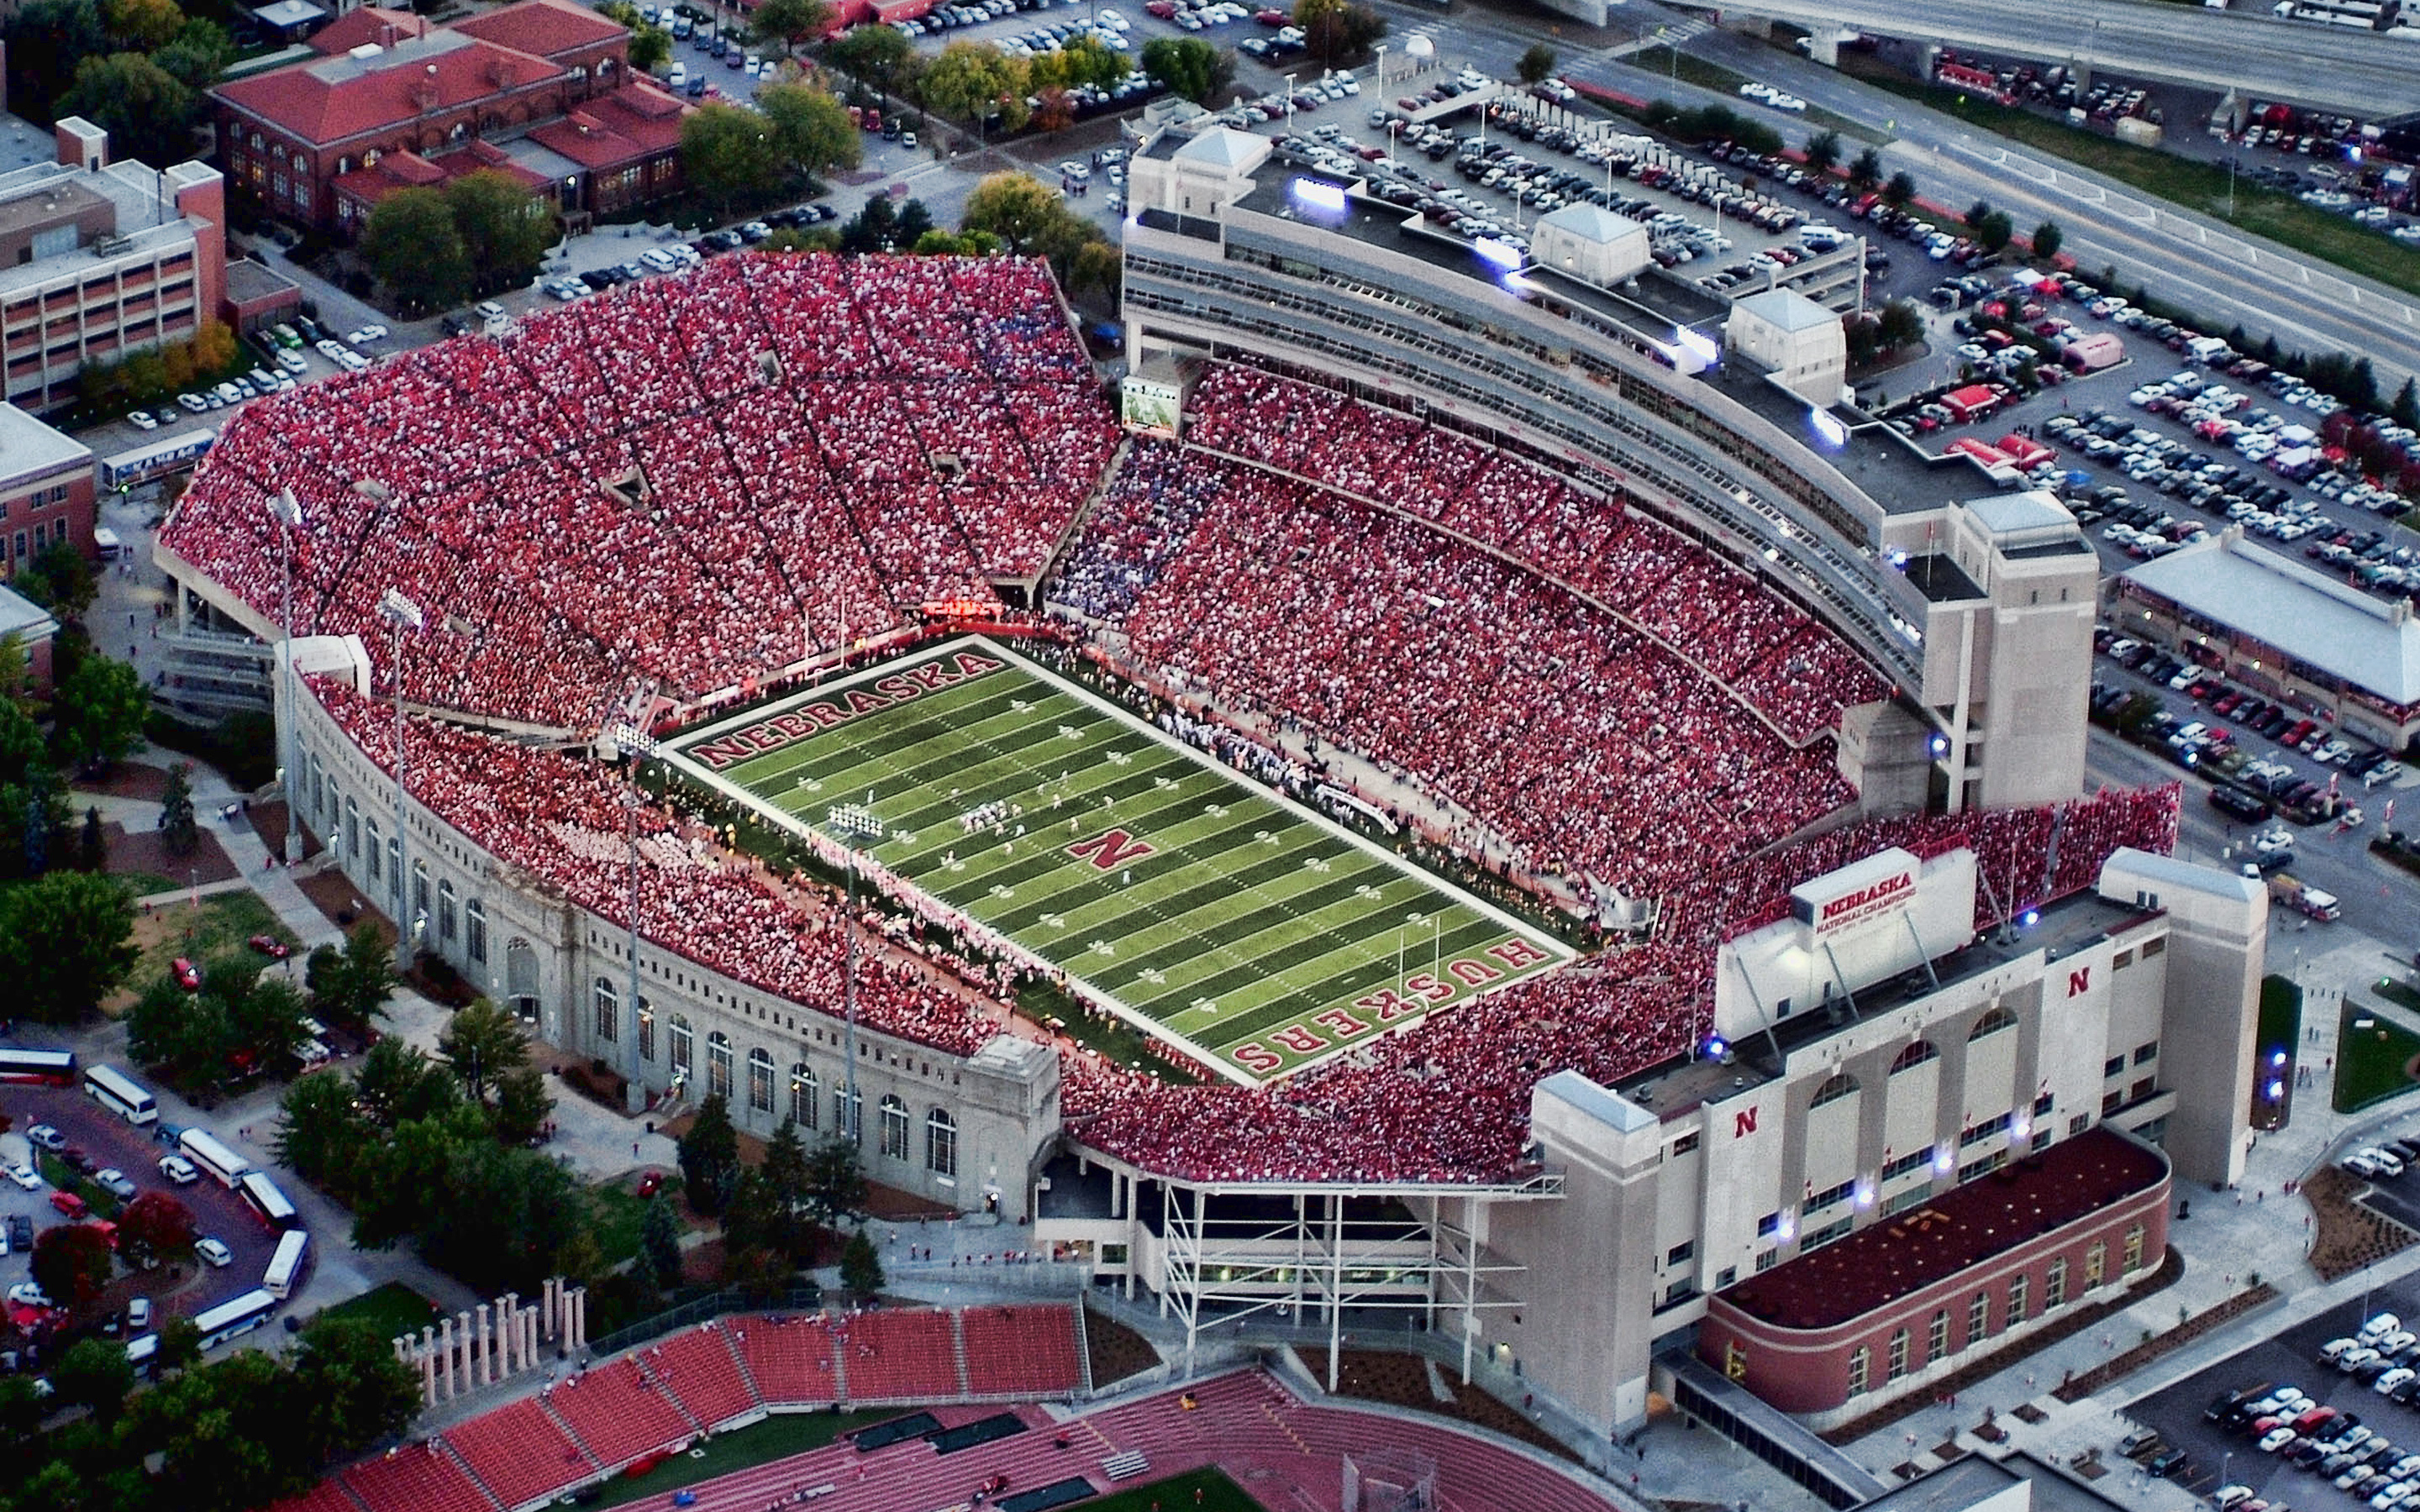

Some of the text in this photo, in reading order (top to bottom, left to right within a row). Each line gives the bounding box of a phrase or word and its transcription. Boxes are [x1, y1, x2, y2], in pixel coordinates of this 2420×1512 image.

[689, 653, 1005, 768] NEBRASKA
[1063, 827, 1159, 873] N
[1822, 871, 1912, 921] NEBRASKA
[1232, 937, 1552, 1074] HUSKERS
[2067, 965, 2091, 998] N
[1733, 1105, 1759, 1140] N
